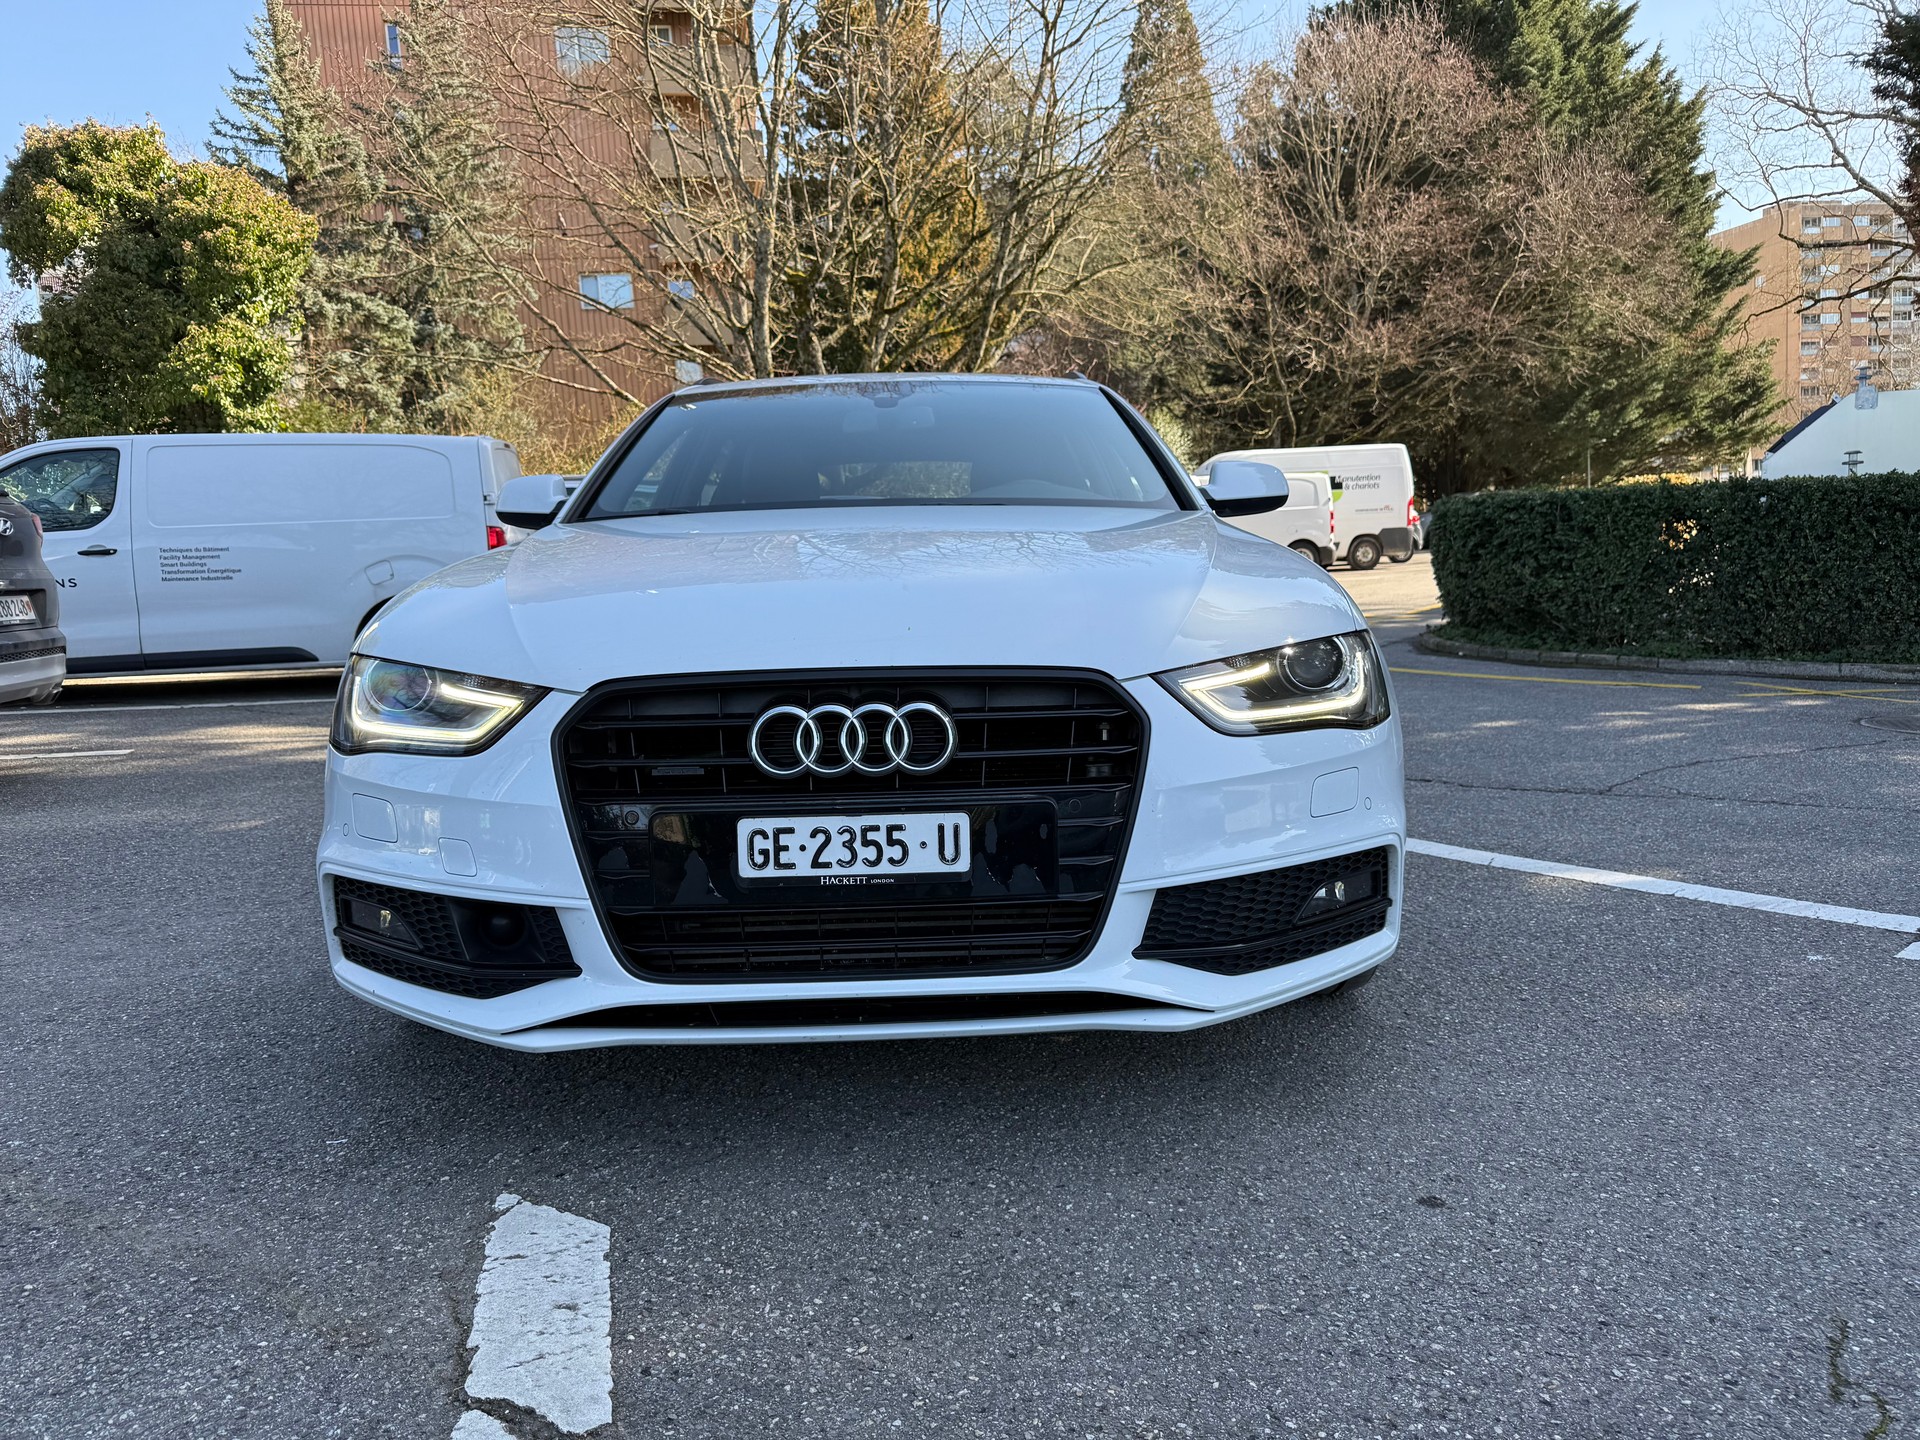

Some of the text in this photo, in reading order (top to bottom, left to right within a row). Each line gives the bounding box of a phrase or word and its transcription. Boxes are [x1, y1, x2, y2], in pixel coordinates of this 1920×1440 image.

[1335, 473, 1380, 483] Manutention
[1351, 481, 1379, 490] chariots
[0, 599, 28, 617] 88248
[820, 876, 867, 885] HACKETT
